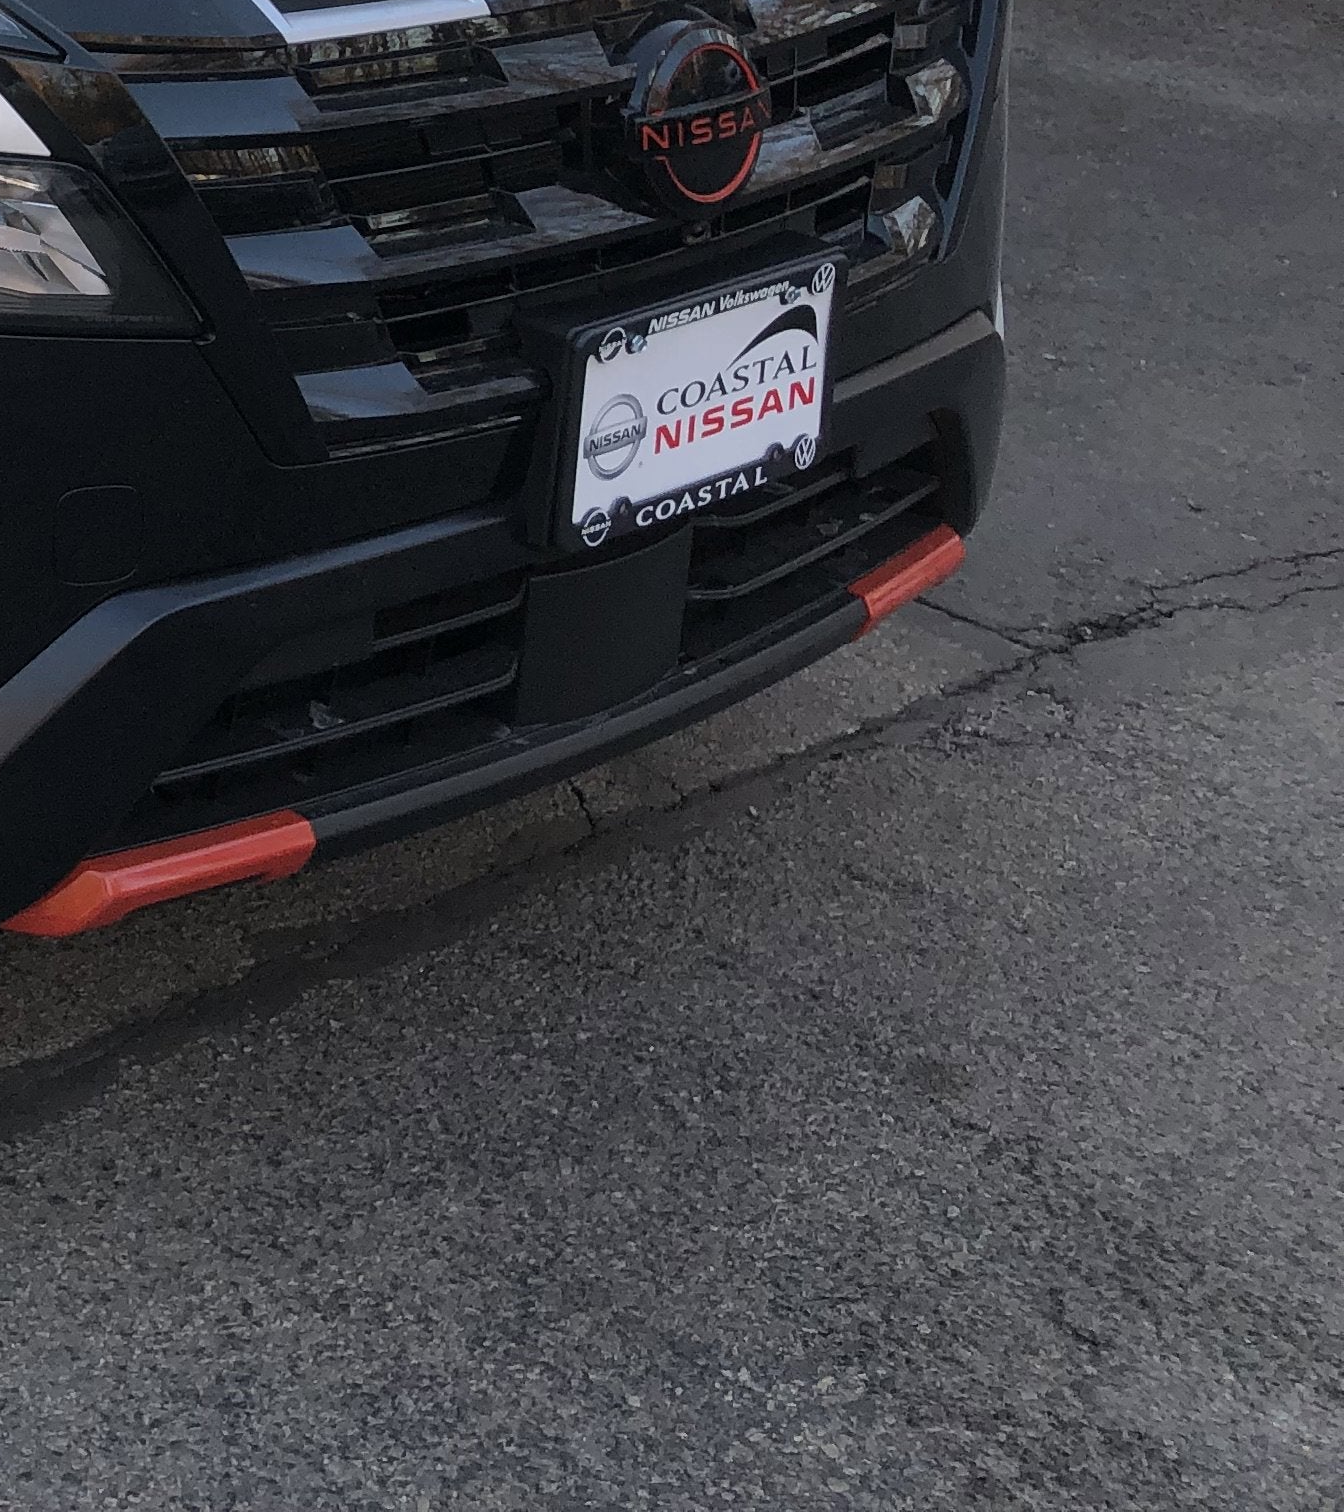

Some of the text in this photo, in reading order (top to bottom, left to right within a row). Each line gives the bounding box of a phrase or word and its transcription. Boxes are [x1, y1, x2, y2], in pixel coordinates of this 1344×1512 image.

[648, 280, 790, 334] NISSAN Volkswagen
[656, 345, 817, 415] COASTAL
[589, 423, 641, 452] NISSAN
[654, 377, 815, 455] NISSAN
[635, 466, 768, 527] COASTAL
